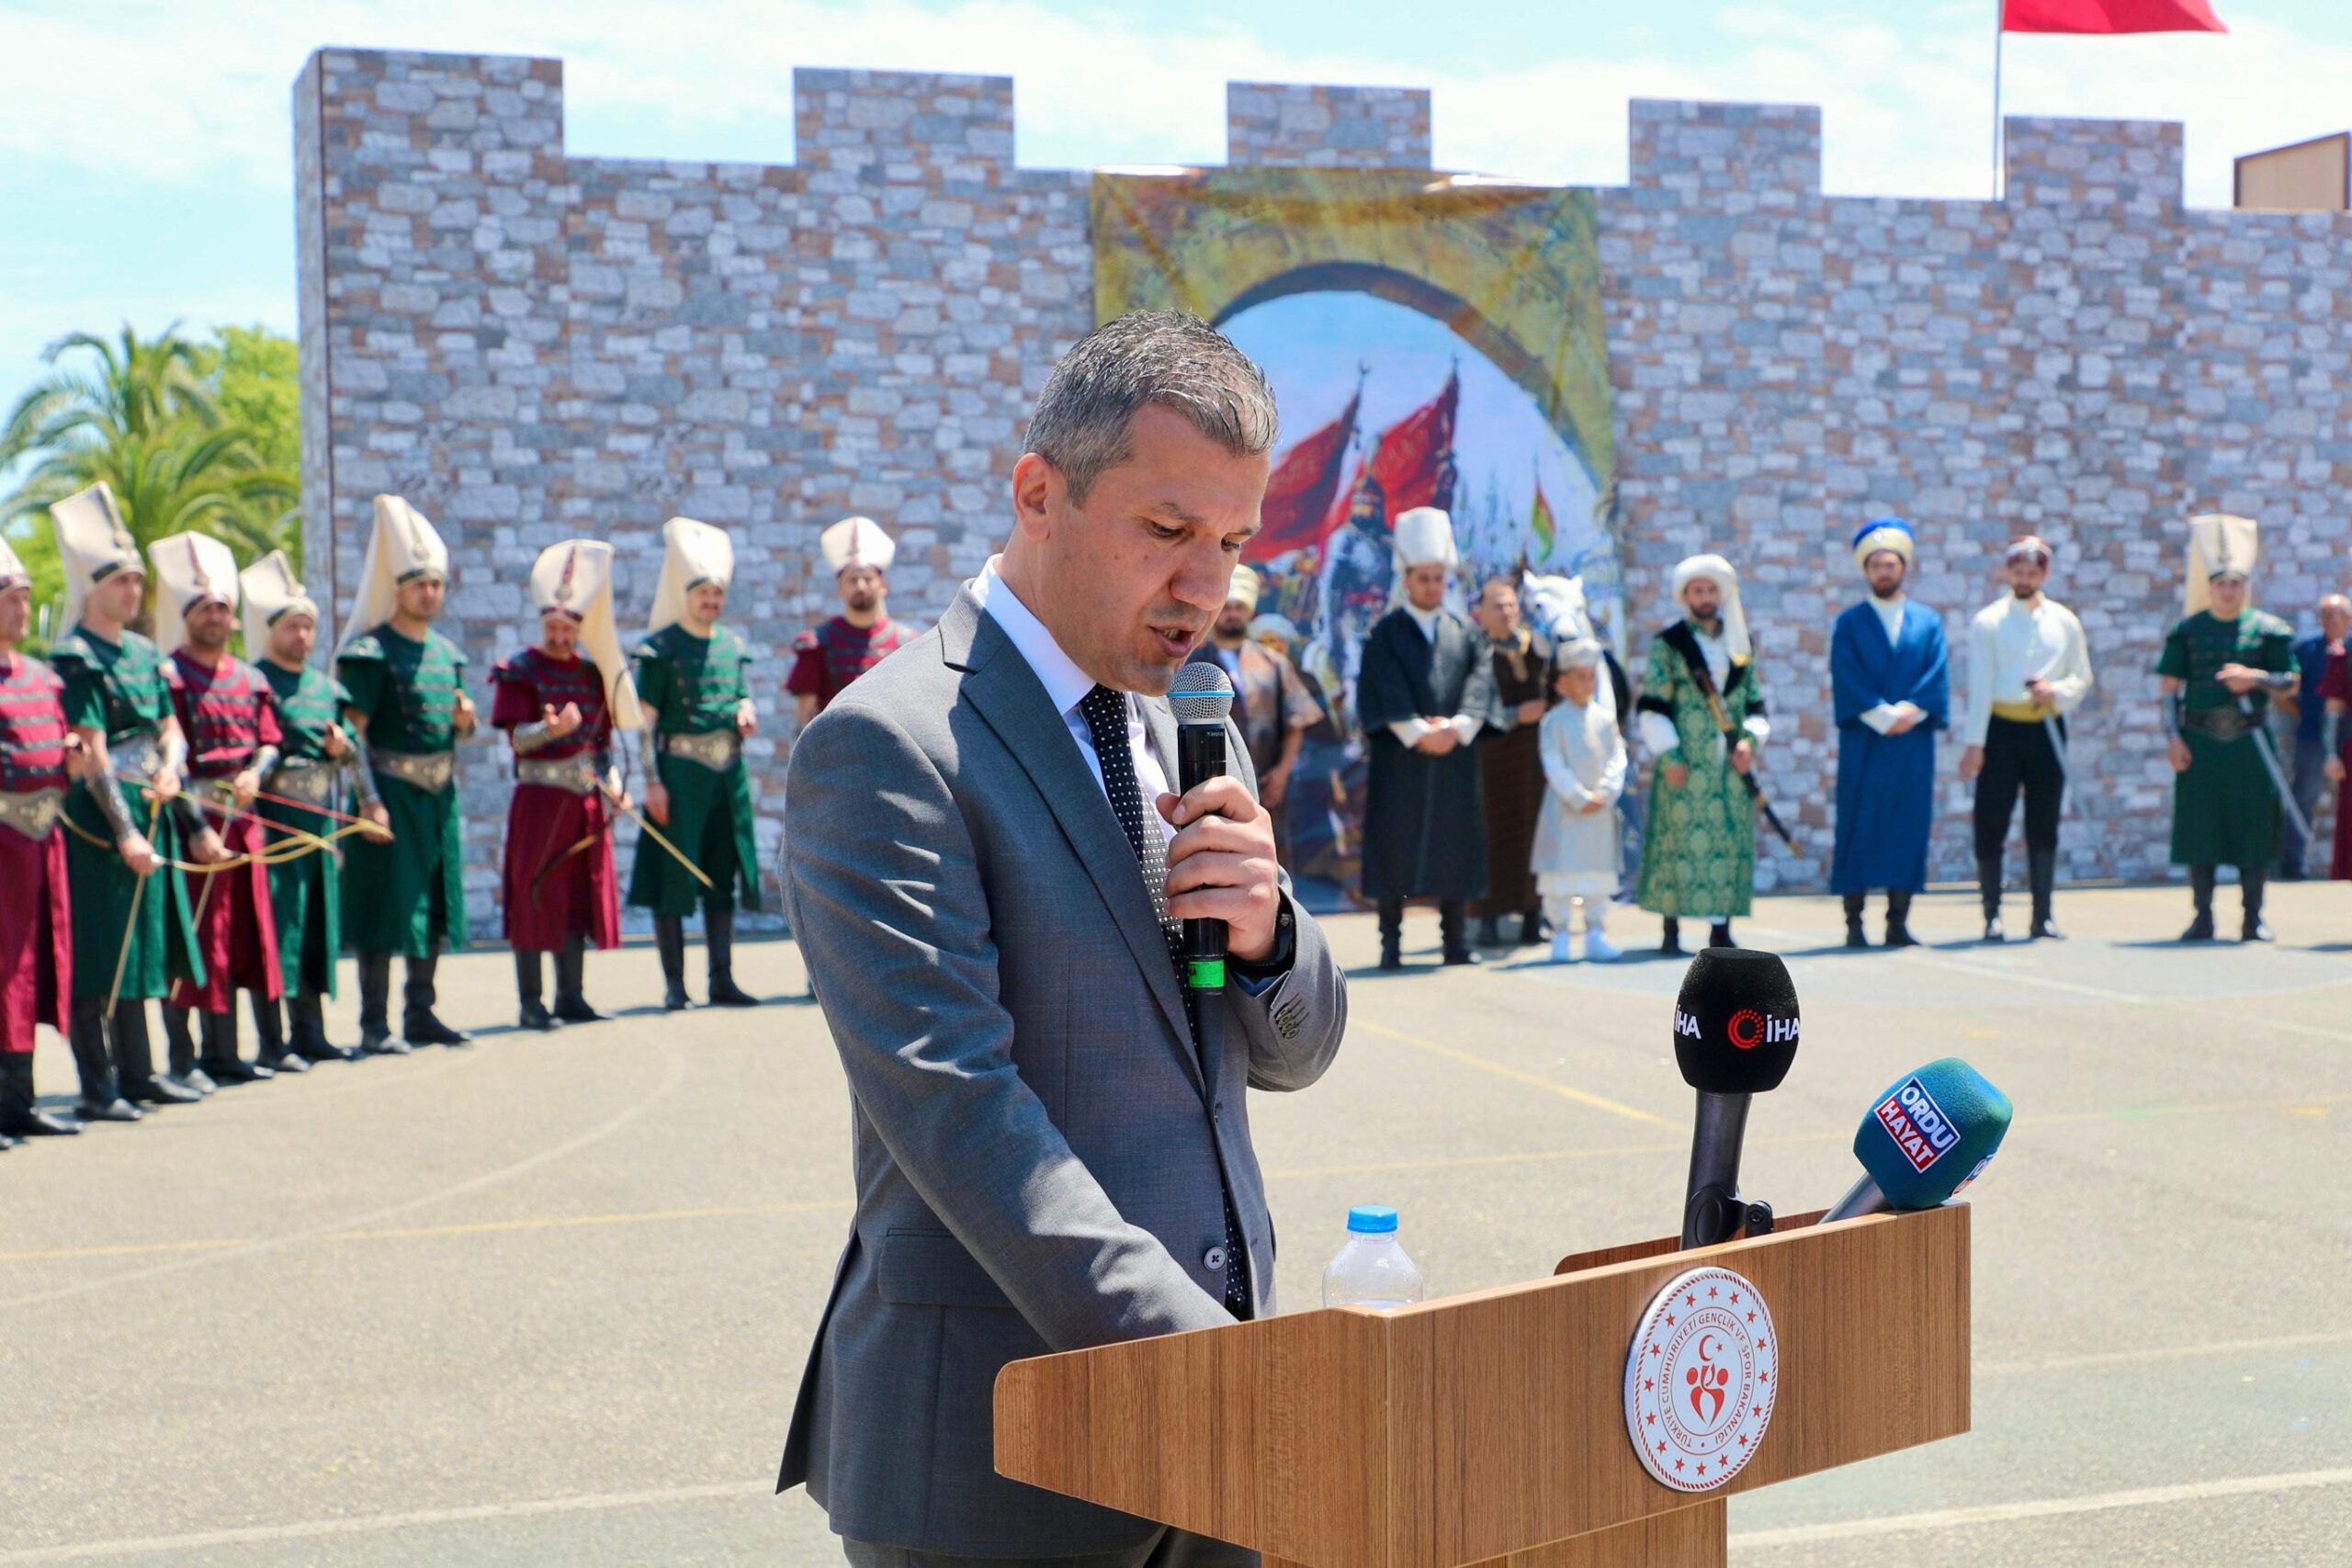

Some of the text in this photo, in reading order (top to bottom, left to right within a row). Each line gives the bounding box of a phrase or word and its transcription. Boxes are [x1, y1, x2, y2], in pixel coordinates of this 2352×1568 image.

[1766, 1014, 1800, 1043] İHA
[1881, 1100, 1934, 1163] HAYAT
[1901, 1087, 1954, 1148] ORDU
[1699, 1313, 1736, 1331] GENÇLİK
[1741, 1345, 1751, 1380] SPOR
